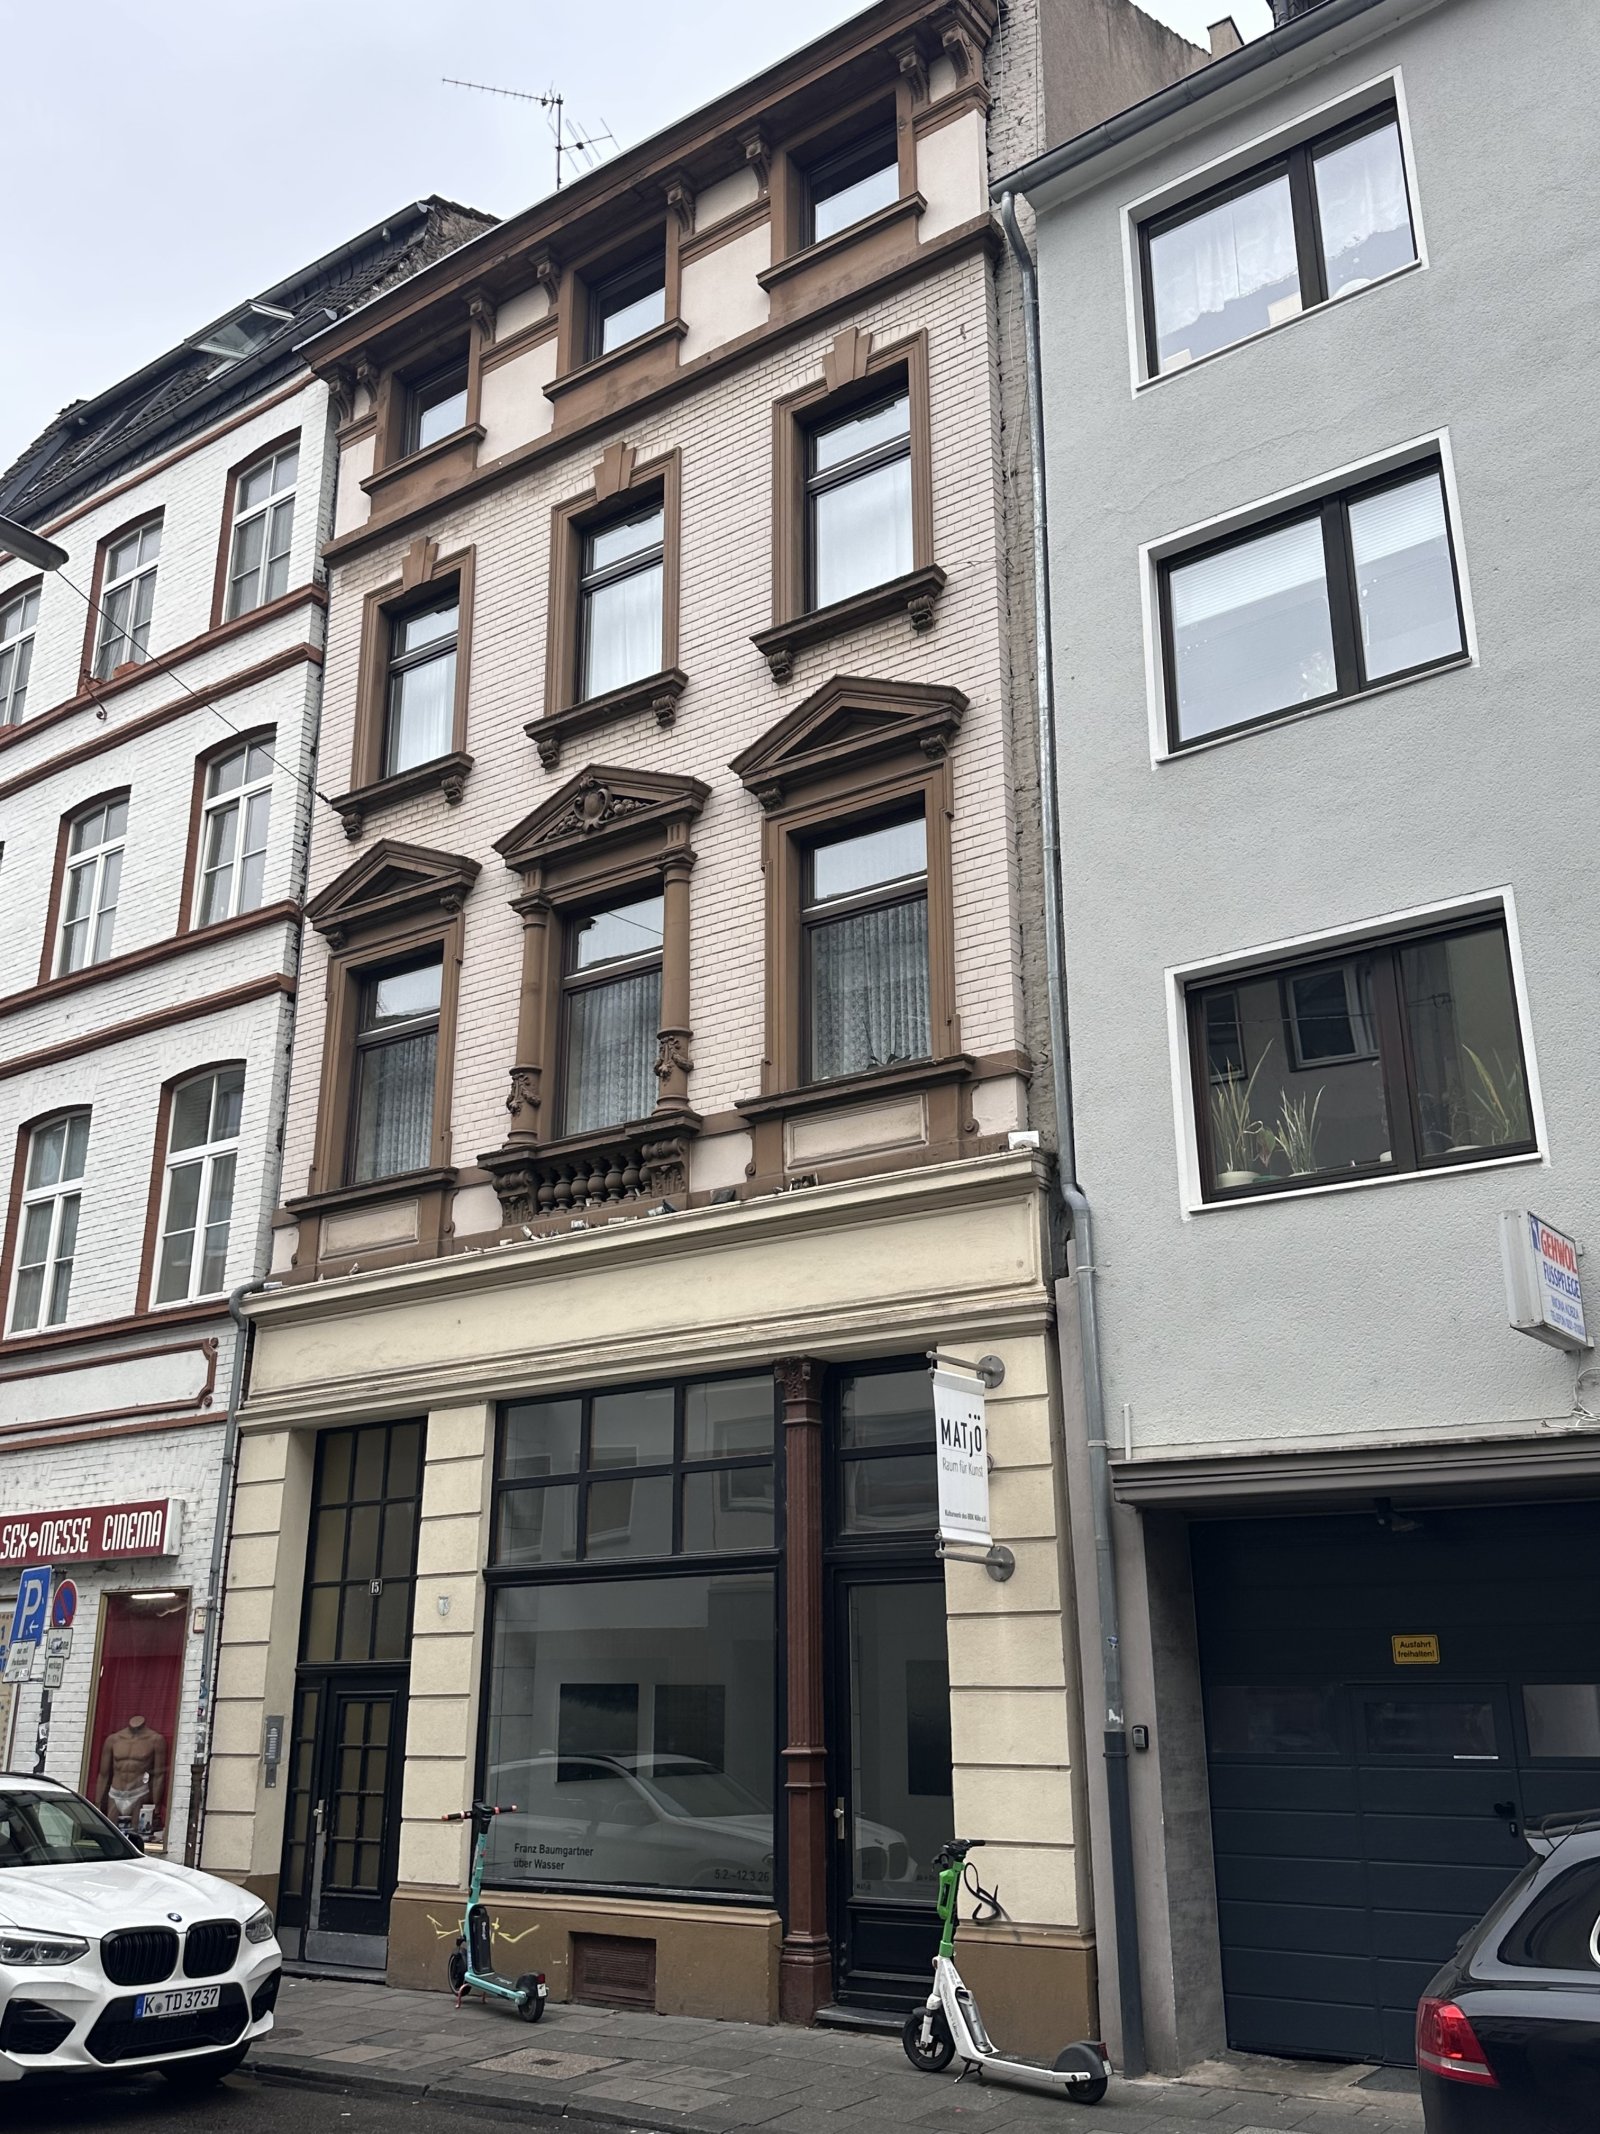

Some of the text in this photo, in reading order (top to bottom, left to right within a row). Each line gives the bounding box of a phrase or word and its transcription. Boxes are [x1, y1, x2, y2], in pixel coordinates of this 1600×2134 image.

[1541, 1228, 1577, 1274] GEHWOL
[1543, 1260, 1580, 1299] FUSSPFLEGE
[942, 1457, 984, 1478] Raum für Kunst
[102, 1509, 163, 1551] CINEMA
[371, 1581, 379, 1594] 15
[18, 1579, 42, 1639] P
[1398, 1650, 1435, 1658] freihalten!
[1400, 1641, 1431, 1649] Ausfahrt
[514, 1842, 594, 1857] Franz Baumgartner
[513, 1857, 565, 1870] über Wasser
[144, 1996, 155, 2014] K
[165, 1993, 182, 2012] TD
[185, 1988, 218, 2009] 3737
